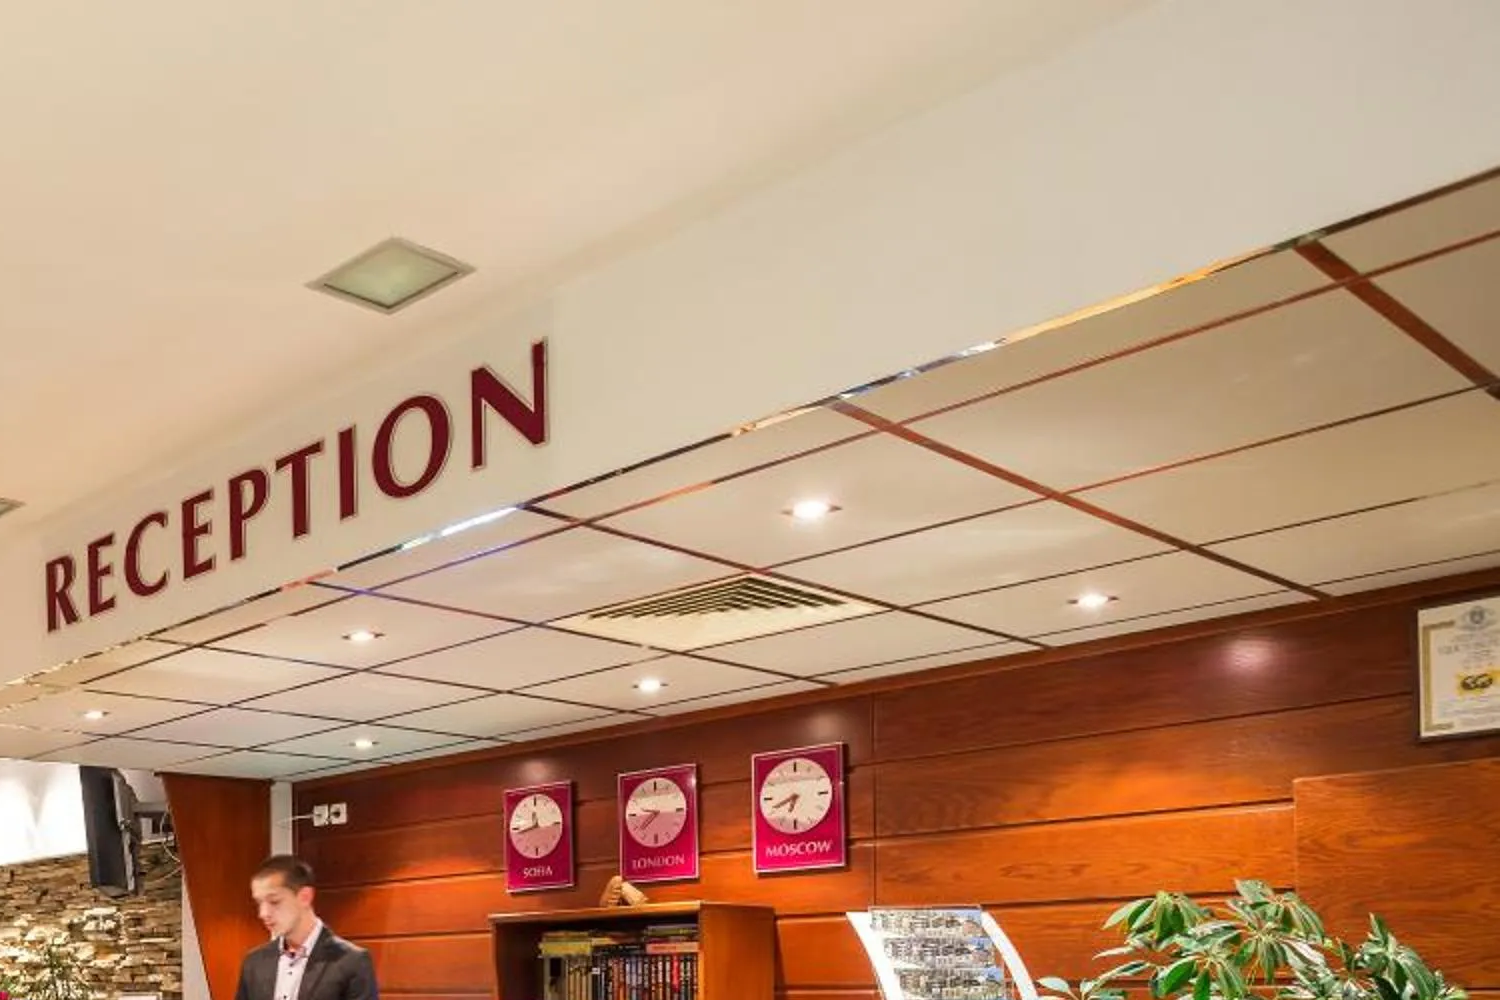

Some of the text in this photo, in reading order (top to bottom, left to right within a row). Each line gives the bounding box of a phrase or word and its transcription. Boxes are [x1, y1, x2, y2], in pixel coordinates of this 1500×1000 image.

[44, 338, 548, 633] RECEPTION
[765, 839, 833, 857] MOSCOW
[632, 853, 685, 870] LONDON
[523, 865, 553, 879] SOFIA
